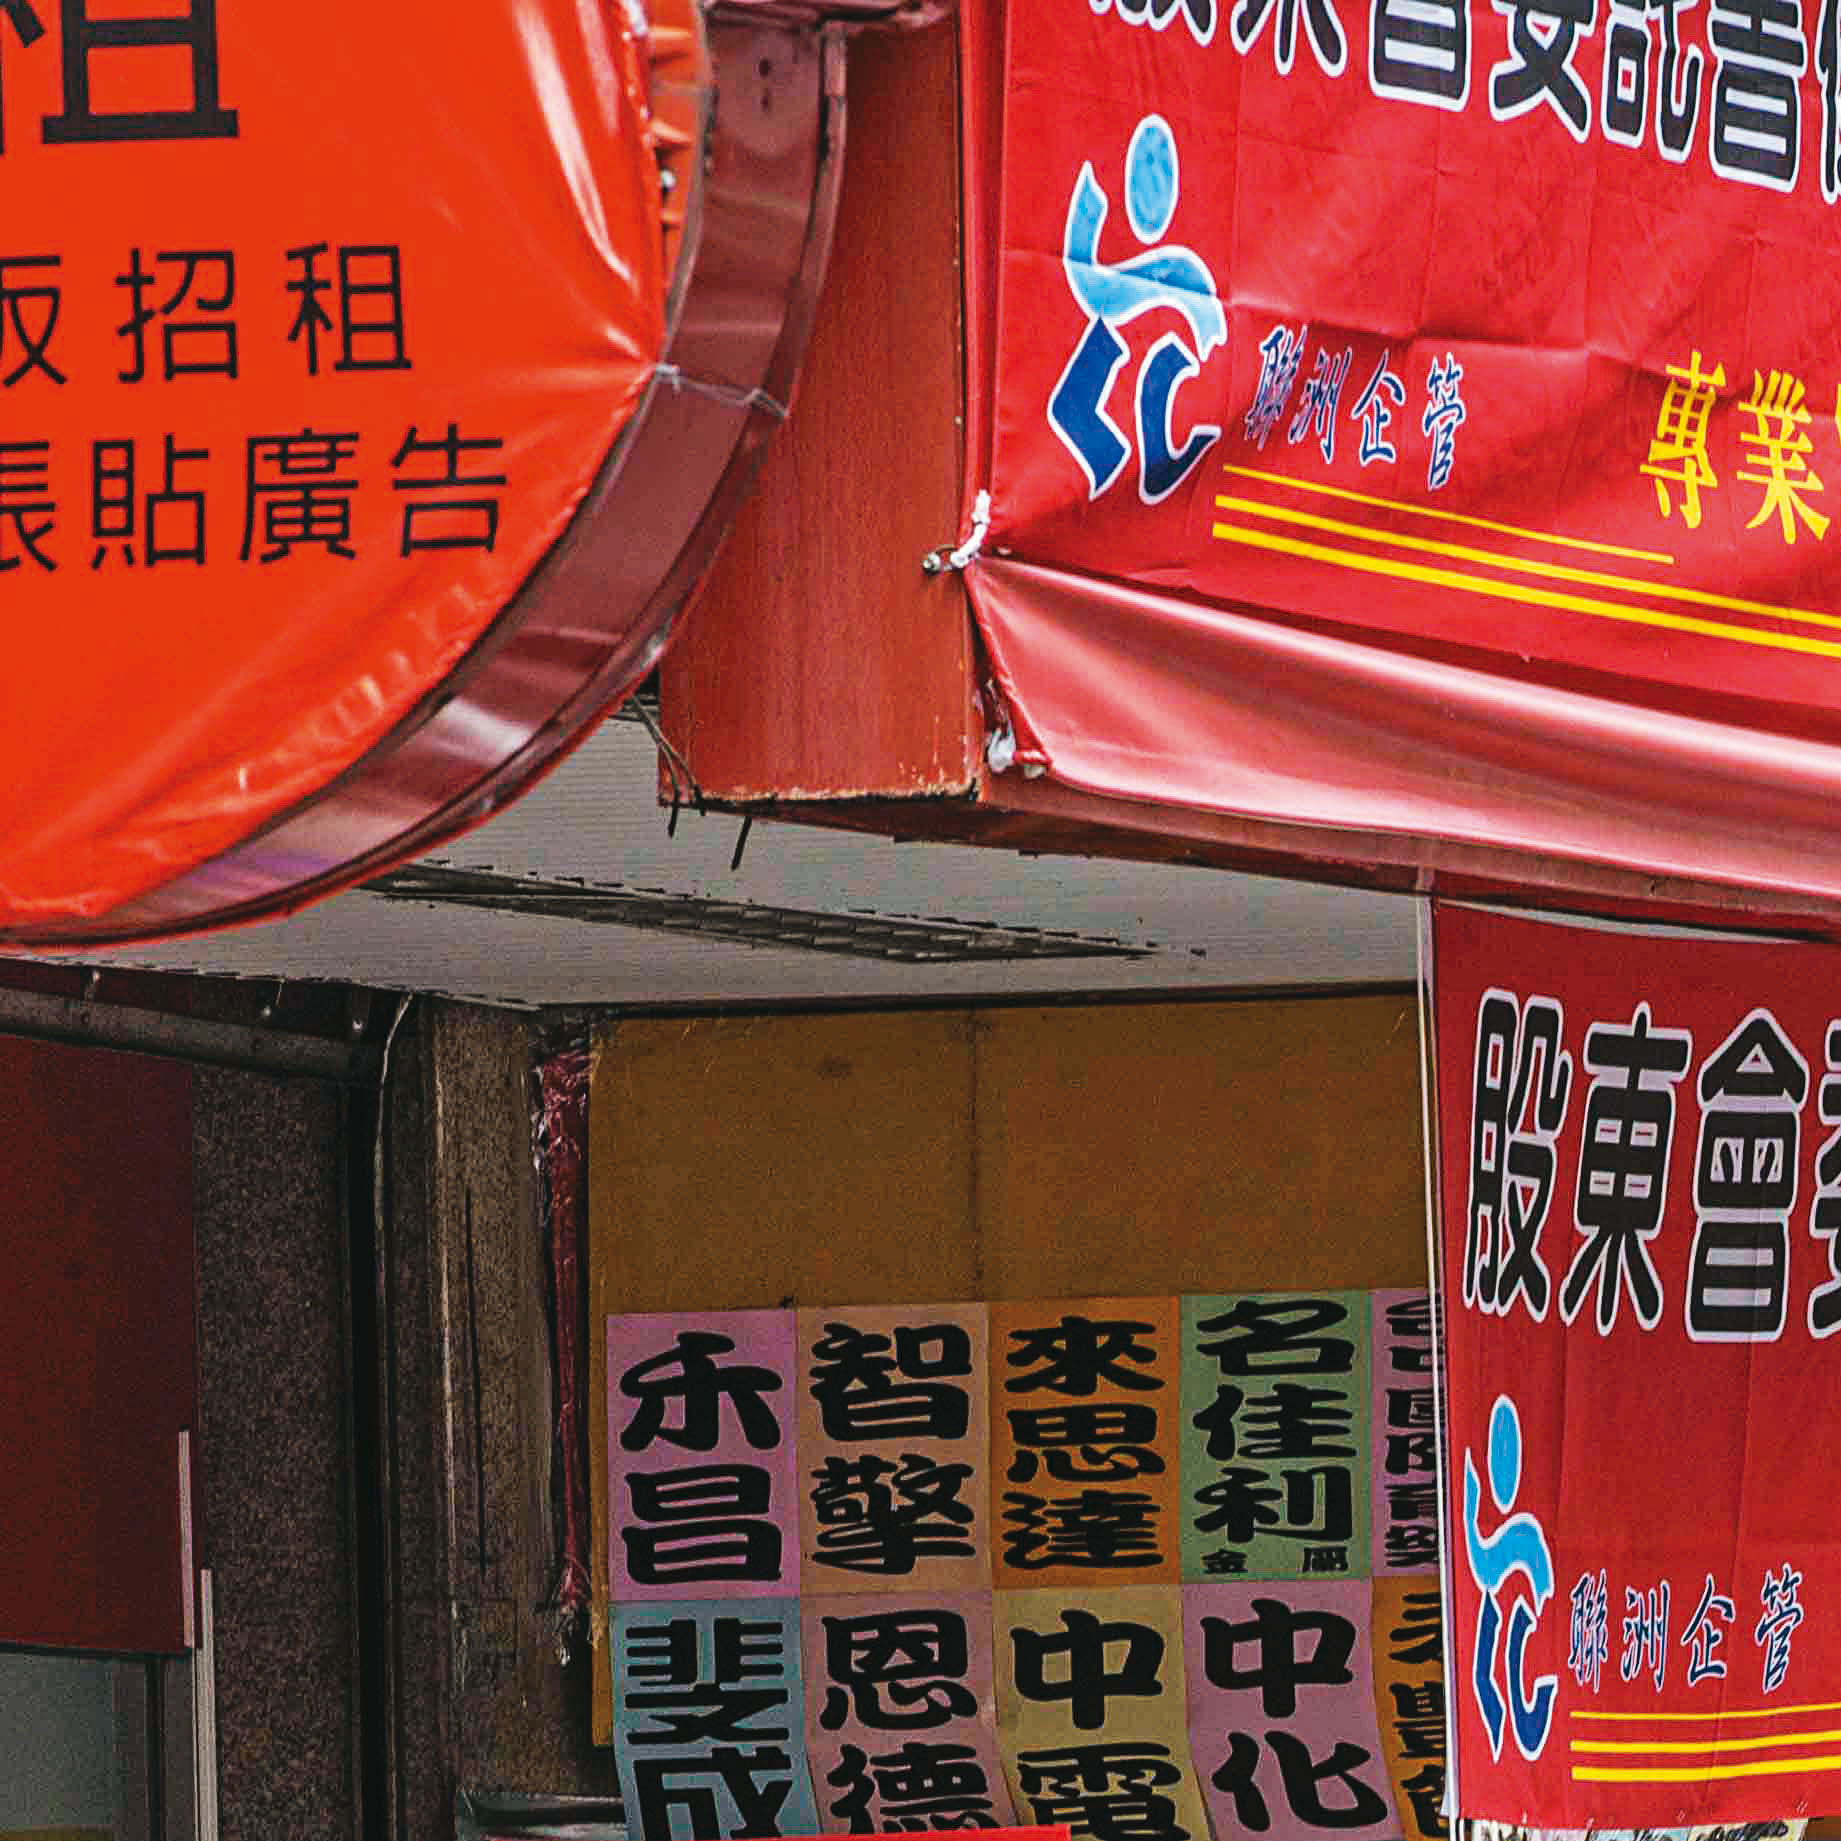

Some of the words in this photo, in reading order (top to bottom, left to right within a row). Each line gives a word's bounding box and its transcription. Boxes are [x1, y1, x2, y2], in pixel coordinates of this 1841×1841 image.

[620, 1332, 782, 1584] 禾昌
[810, 1324, 975, 1574] 智擎
[1003, 1316, 1165, 1569] 來思達
[1193, 1300, 1356, 1544] 名佳利
[625, 1618, 792, 1841] 斐成
[820, 1610, 1000, 1834] 恩德
[1201, 1599, 1394, 1831] 中化
[1567, 1562, 1805, 1697] 聯洲企管
